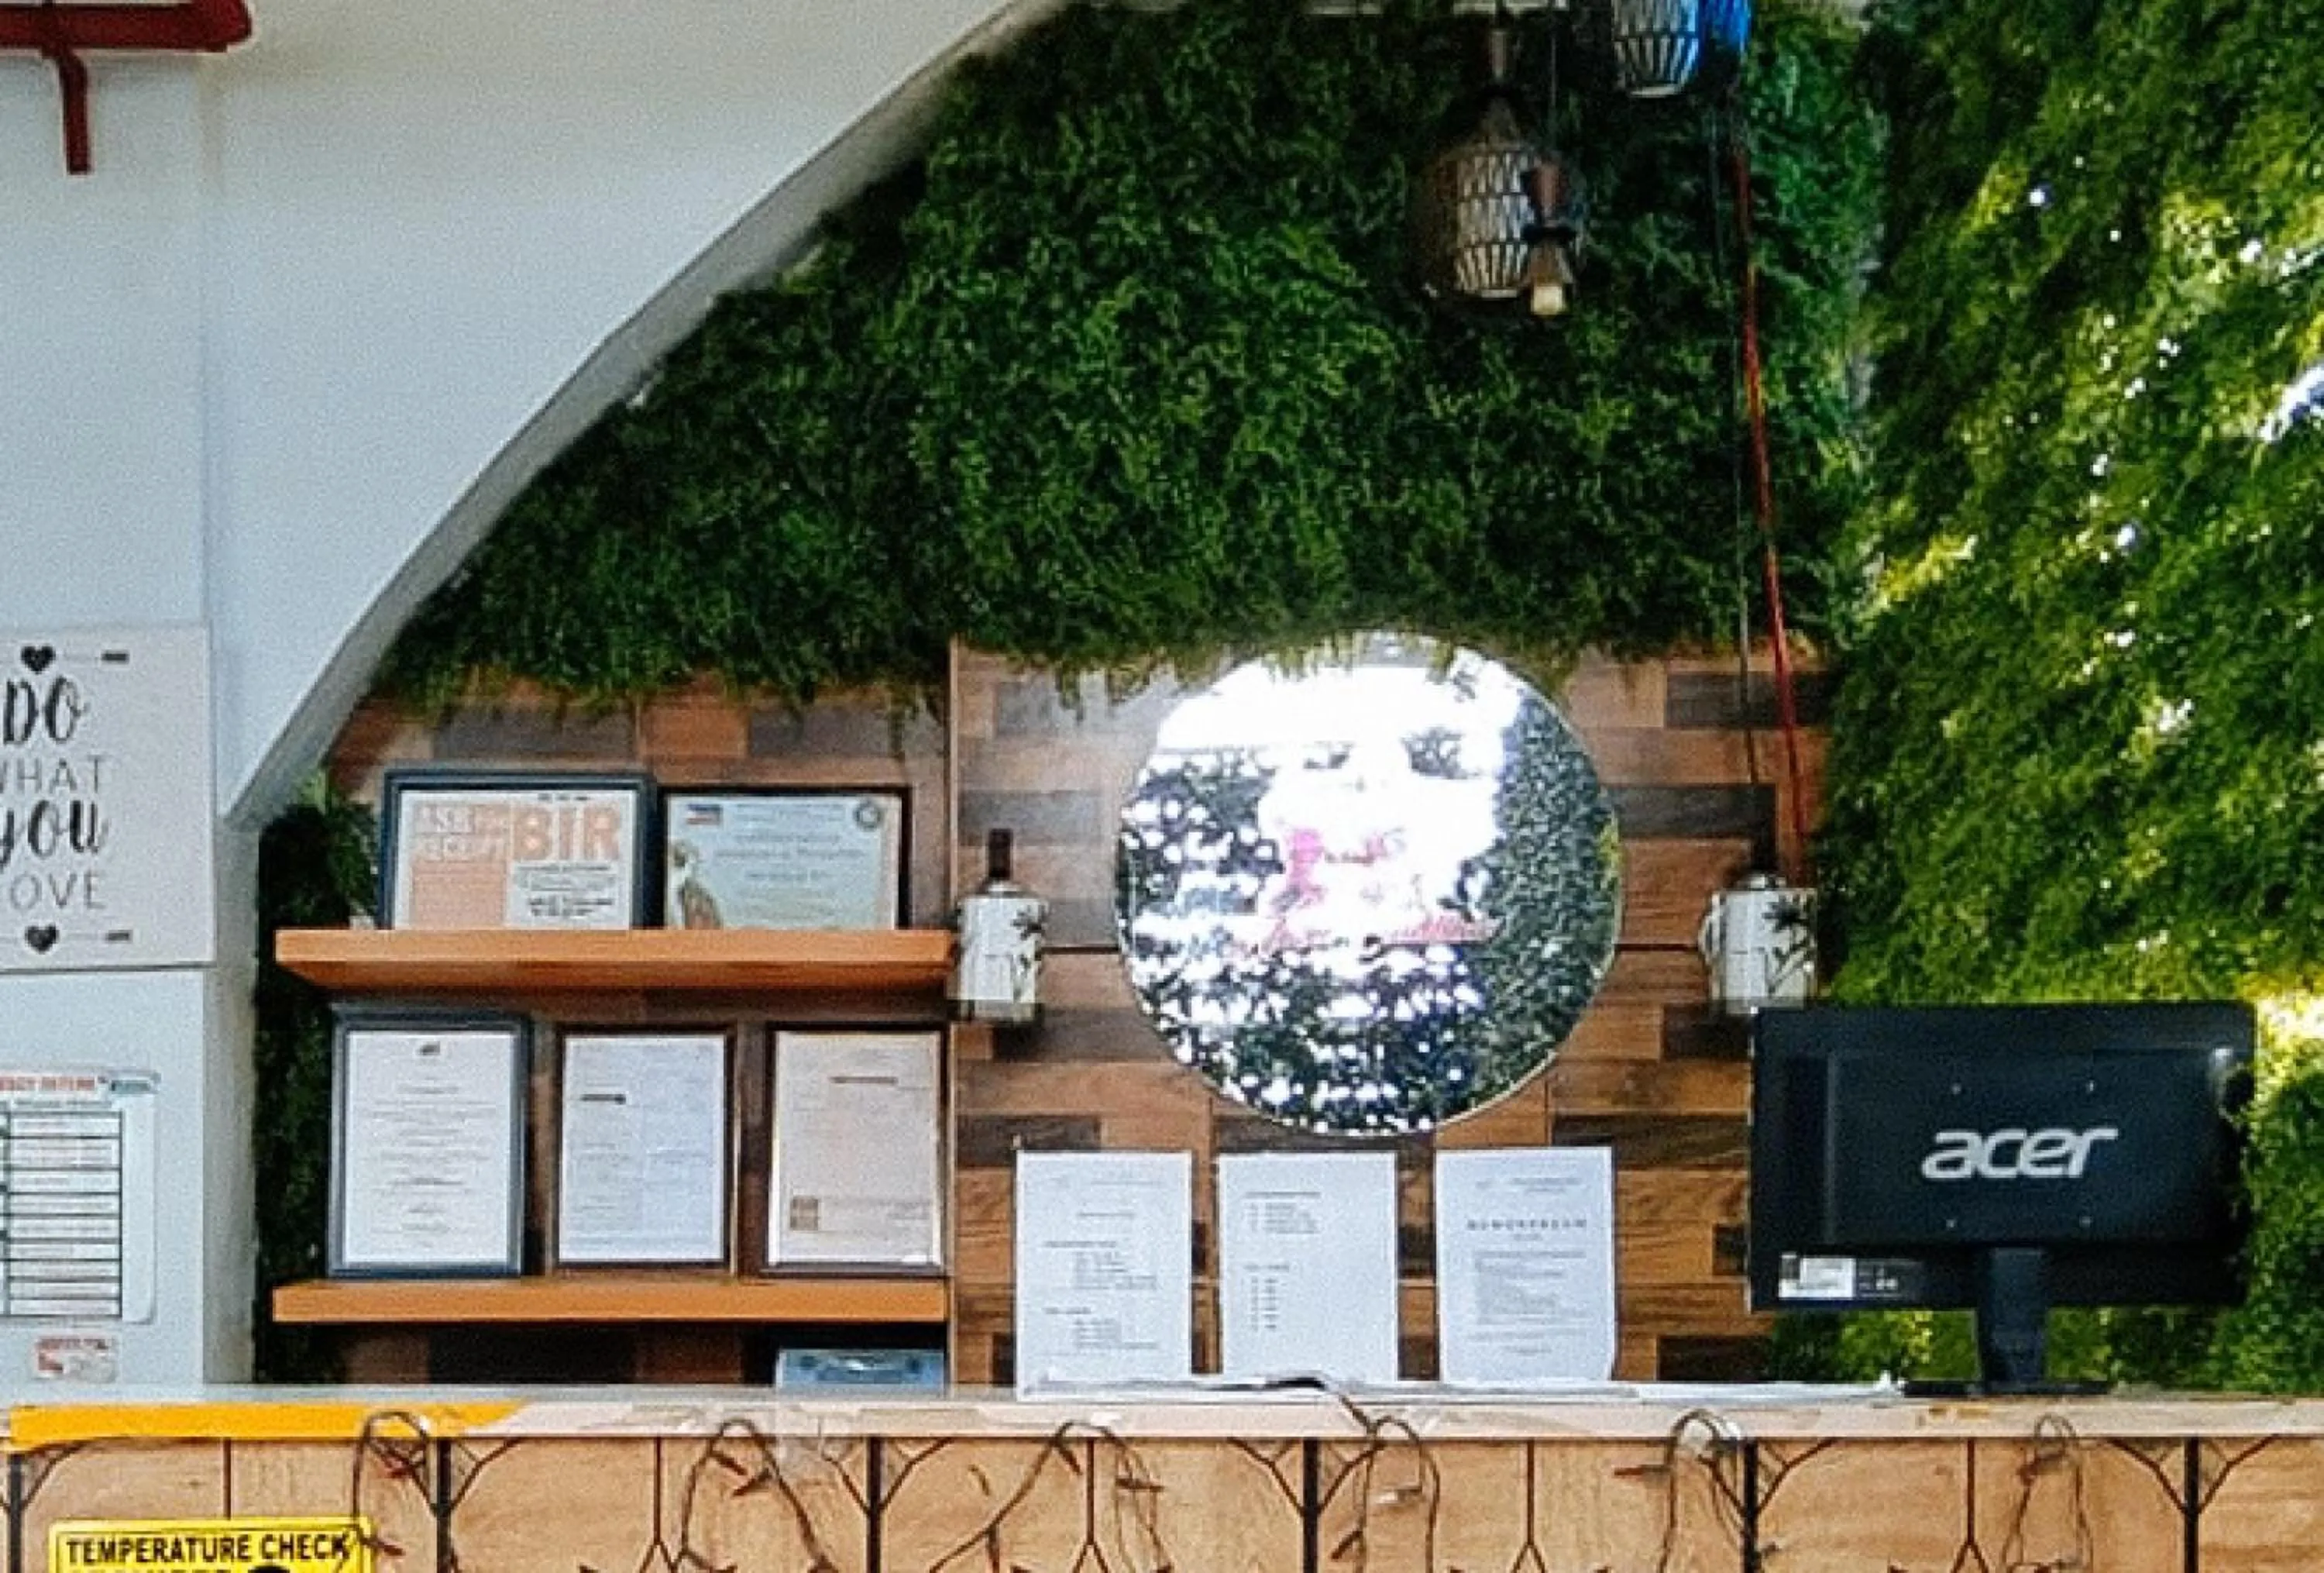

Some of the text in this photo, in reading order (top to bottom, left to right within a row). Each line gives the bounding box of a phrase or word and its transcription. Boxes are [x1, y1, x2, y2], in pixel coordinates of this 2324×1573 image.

[3, 675, 89, 745] DO
[513, 804, 621, 862] BIR
[9, 871, 106, 910] OVE
[1921, 1128, 2119, 1179] acer
[65, 1532, 351, 1564] TEMPERATURE CHECK
